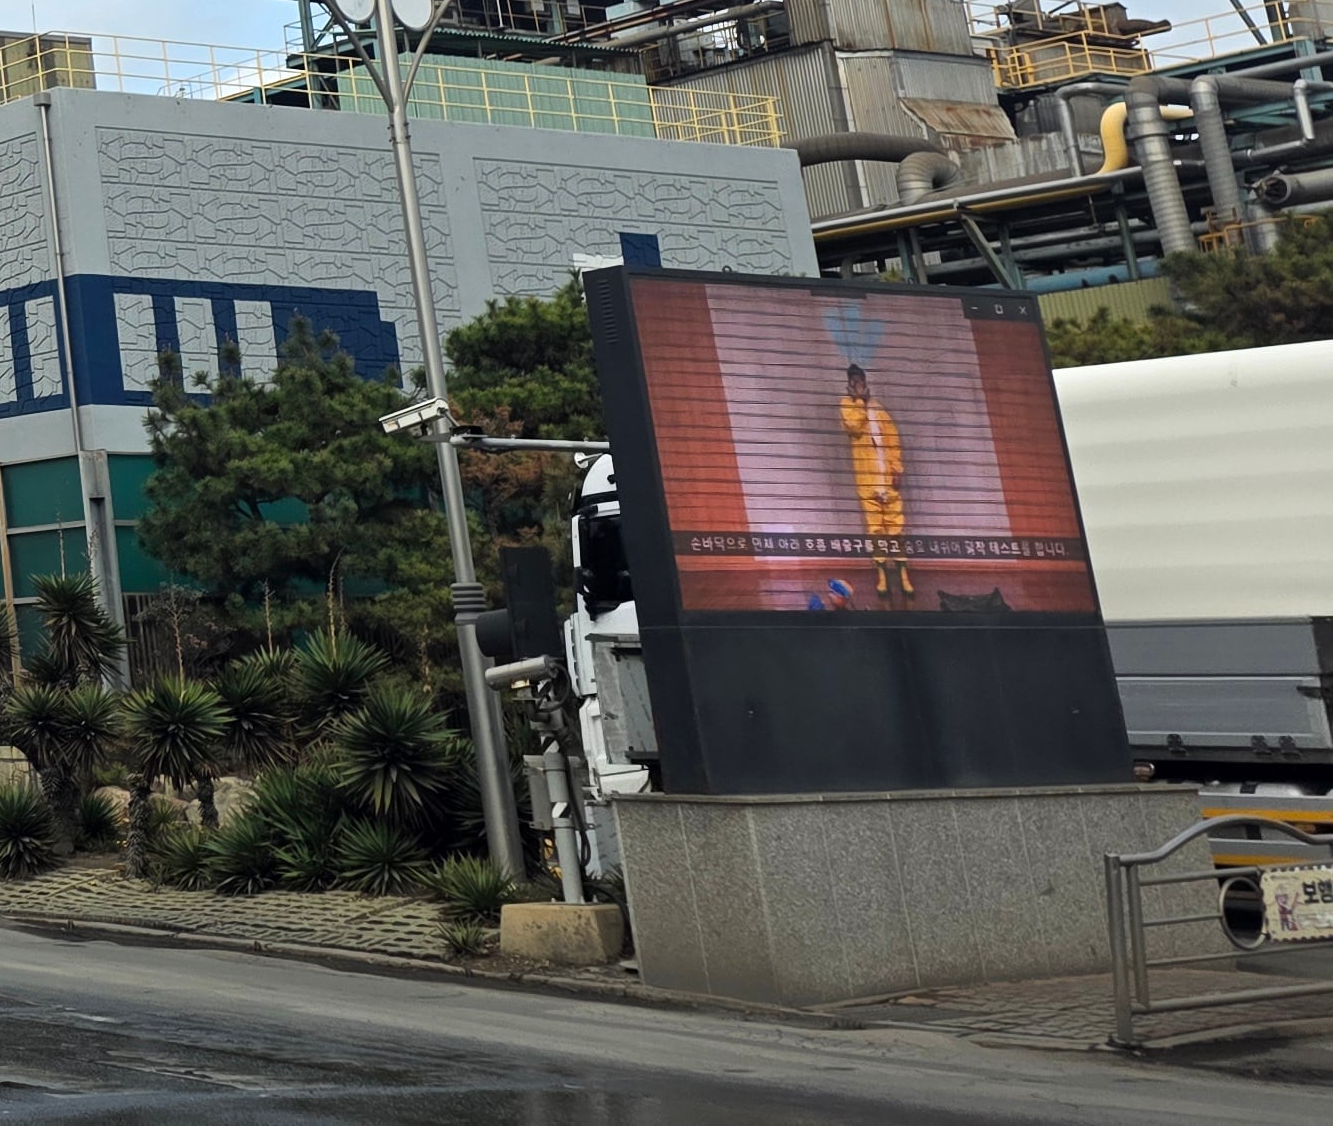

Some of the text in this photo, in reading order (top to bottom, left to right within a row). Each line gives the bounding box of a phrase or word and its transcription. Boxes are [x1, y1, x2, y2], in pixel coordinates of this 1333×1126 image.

[690, 537, 748, 551] 손바닥으로
[805, 538, 827, 552] 호흡
[830, 539, 874, 554] 배출구를
[877, 539, 901, 554] 막고
[904, 540, 925, 554] 숨을
[989, 541, 1031, 557] 테스트를
[1034, 541, 1070, 557] 합니다.
